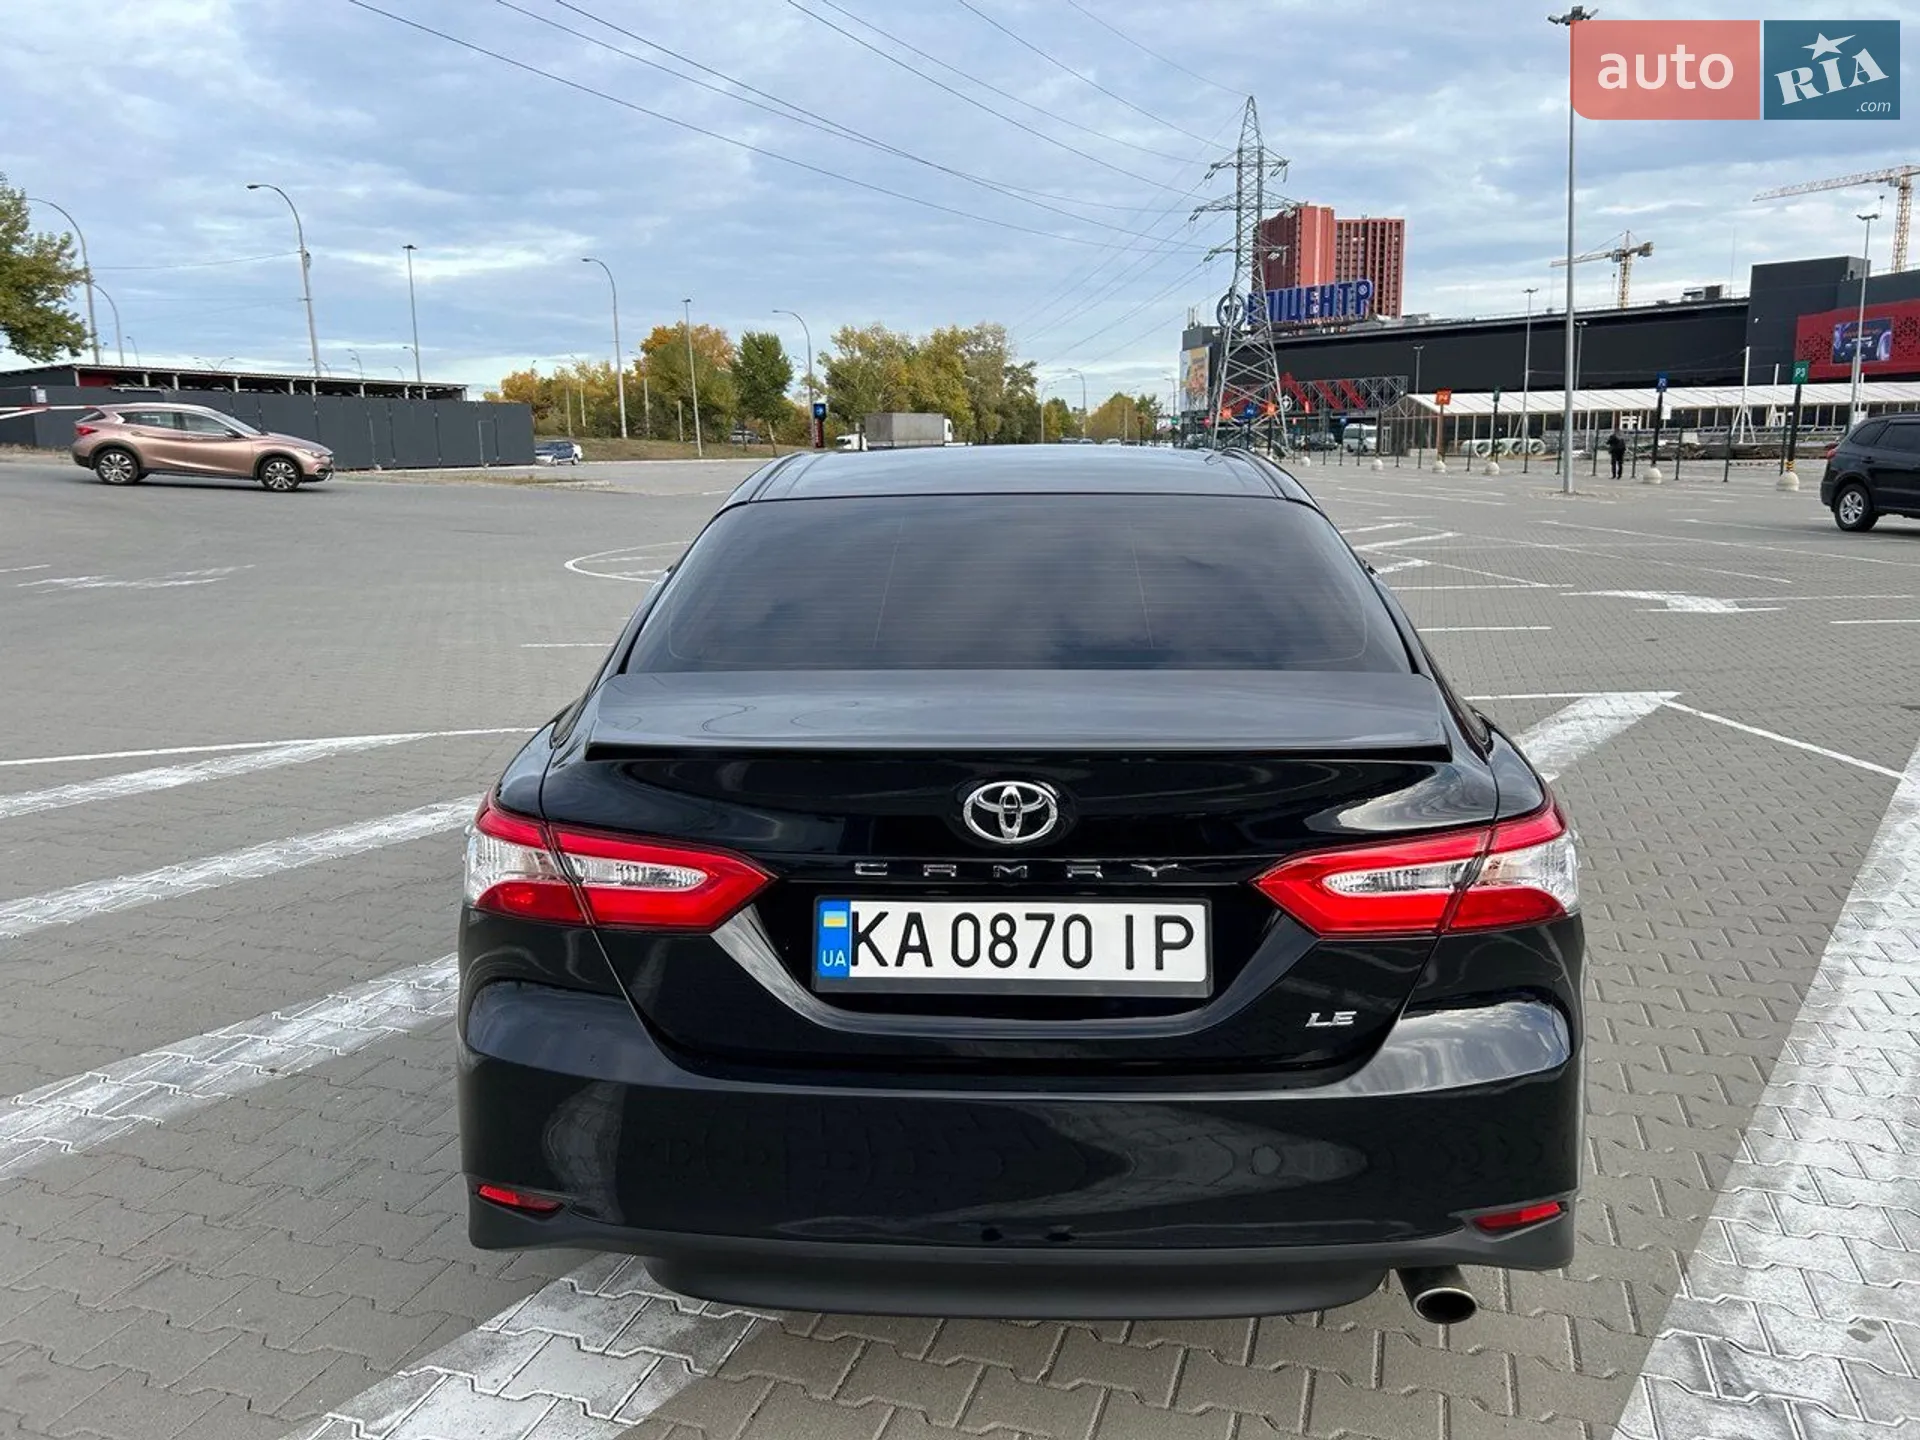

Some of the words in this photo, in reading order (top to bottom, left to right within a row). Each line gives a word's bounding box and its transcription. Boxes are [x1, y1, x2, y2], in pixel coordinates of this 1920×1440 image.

[854, 862, 1178, 879] CAMRY
[850, 910, 934, 968] KA
[951, 911, 1093, 970] 0870
[1124, 914, 1194, 971] IP
[822, 949, 847, 967] UA
[1305, 1010, 1357, 1028] LE
